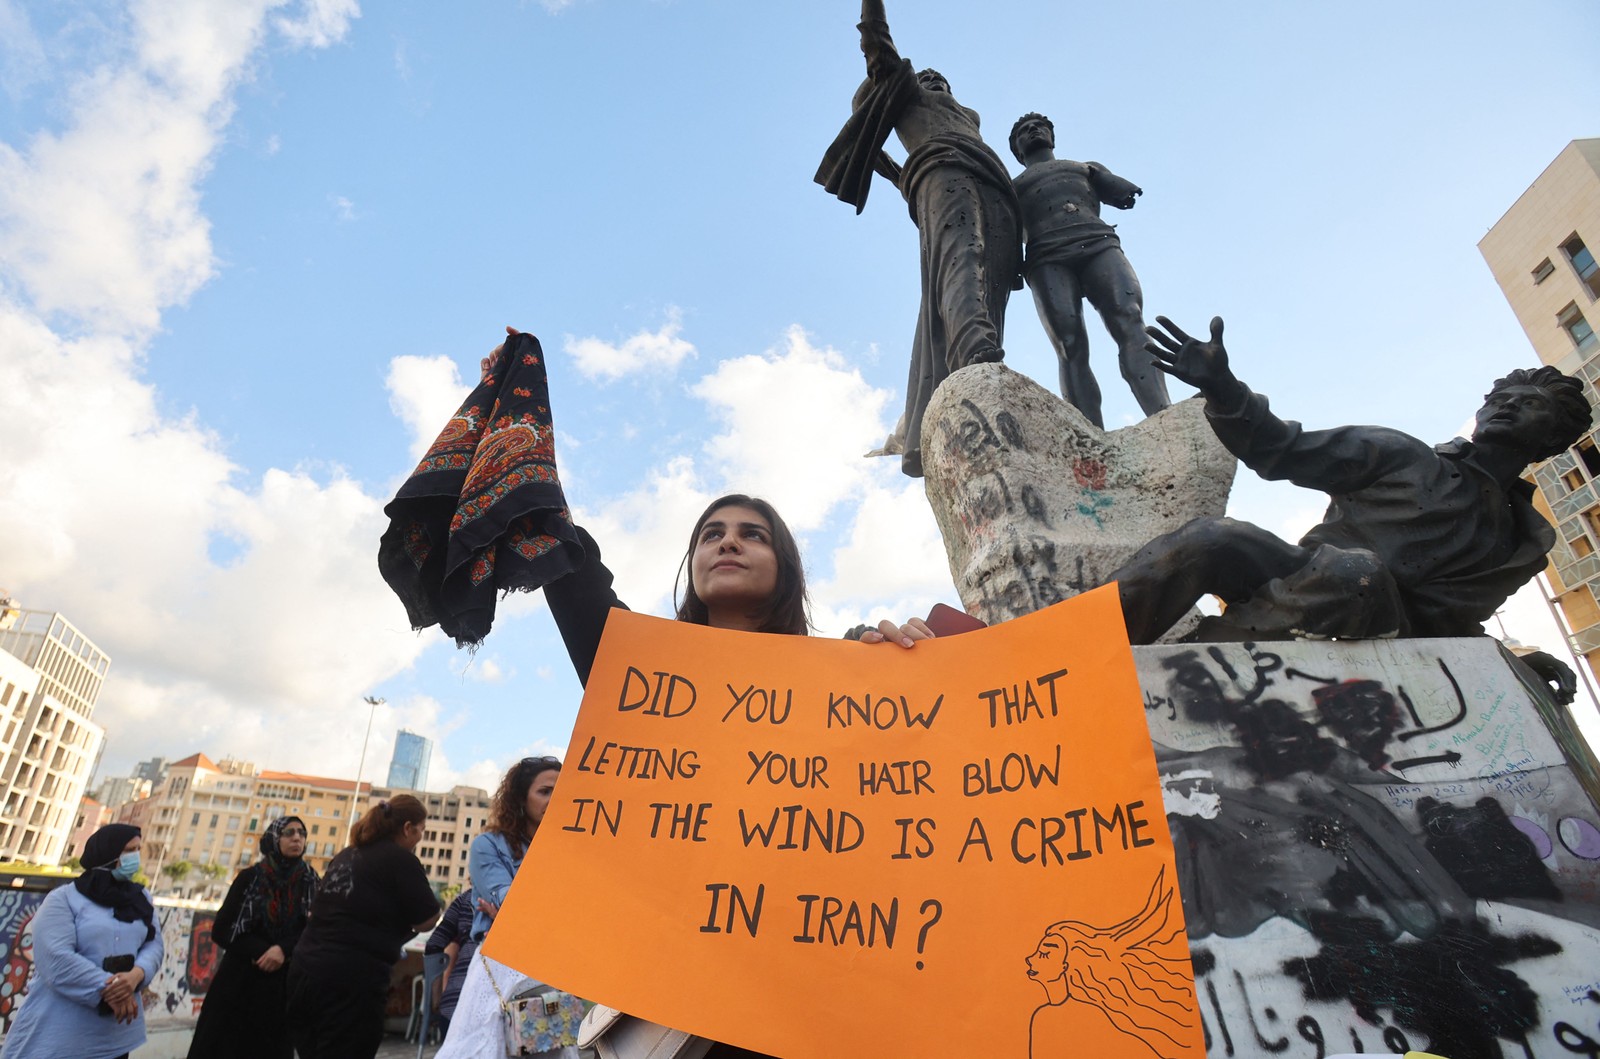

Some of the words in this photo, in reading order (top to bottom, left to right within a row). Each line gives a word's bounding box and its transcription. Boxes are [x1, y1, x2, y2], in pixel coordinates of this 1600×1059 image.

[618, 666, 696, 718] DID
[722, 684, 792, 724] YOU
[828, 693, 943, 730] KNOW
[979, 669, 1067, 728] THAT
[578, 736, 700, 780] LETTING
[747, 751, 829, 788] YOUR
[859, 760, 934, 795] HAIR
[964, 745, 1060, 796] BLOW
[563, 799, 622, 836] IN
[650, 803, 712, 841] THE
[739, 805, 864, 853] WIND
[892, 818, 935, 859] IS
[958, 818, 992, 862] A
[1011, 801, 1154, 867] CRIME
[700, 884, 764, 937] IN
